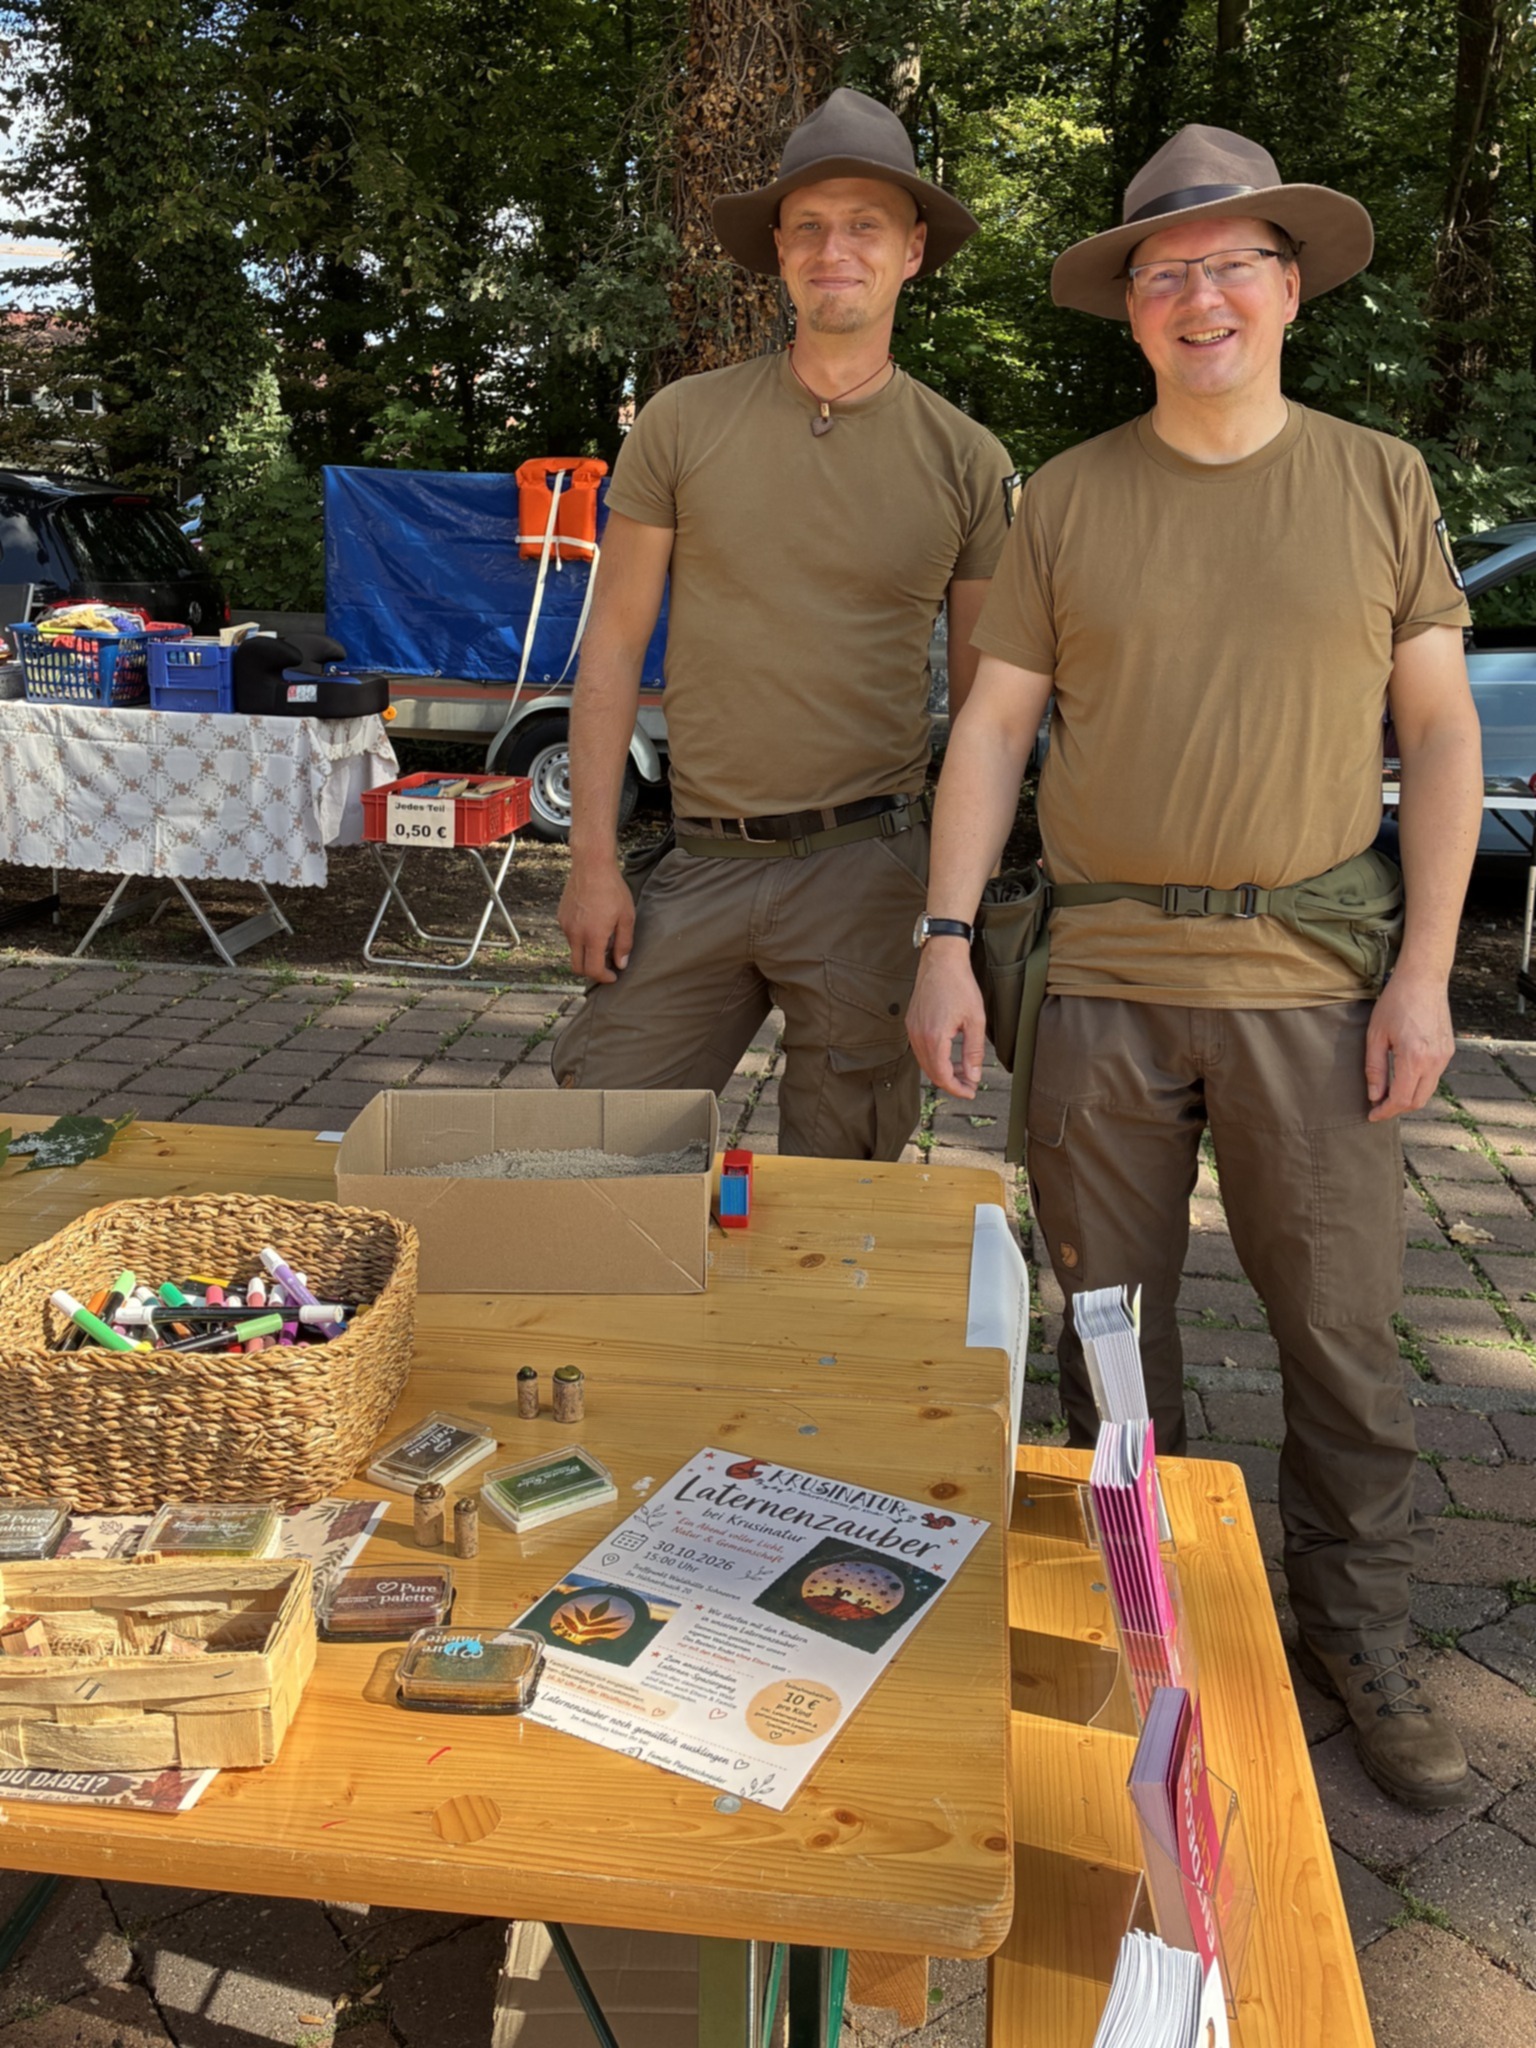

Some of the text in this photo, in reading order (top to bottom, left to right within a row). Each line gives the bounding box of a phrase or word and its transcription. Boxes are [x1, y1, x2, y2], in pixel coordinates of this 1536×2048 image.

[395, 802, 446, 812] Jedes Teil
[395, 823, 447, 839] 0,50 €
[768, 1469, 907, 1517] KRUSINATUR
[674, 1474, 941, 1558] Laternenzauber
[702, 1508, 805, 1542] bei Krusinatur
[678, 1517, 694, 1527] Ein
[697, 1523, 728, 1536] Abend
[729, 1534, 754, 1543] voller
[672, 1526, 700, 1538] Natur
[717, 1540, 783, 1563] Gemeinschaft
[644, 1552, 699, 1572] 15:00 Uhr
[654, 1541, 734, 1570] 30.10.2026
[400, 1583, 436, 1592] Pure
[380, 1593, 435, 1604] palette
[784, 1692, 820, 1711] 10 €
[792, 1708, 812, 1718] Kind
[541, 1693, 729, 1764] Laternenzauber noch gemütlich ausklingen
[30, 1772, 110, 1793] DABEI?
